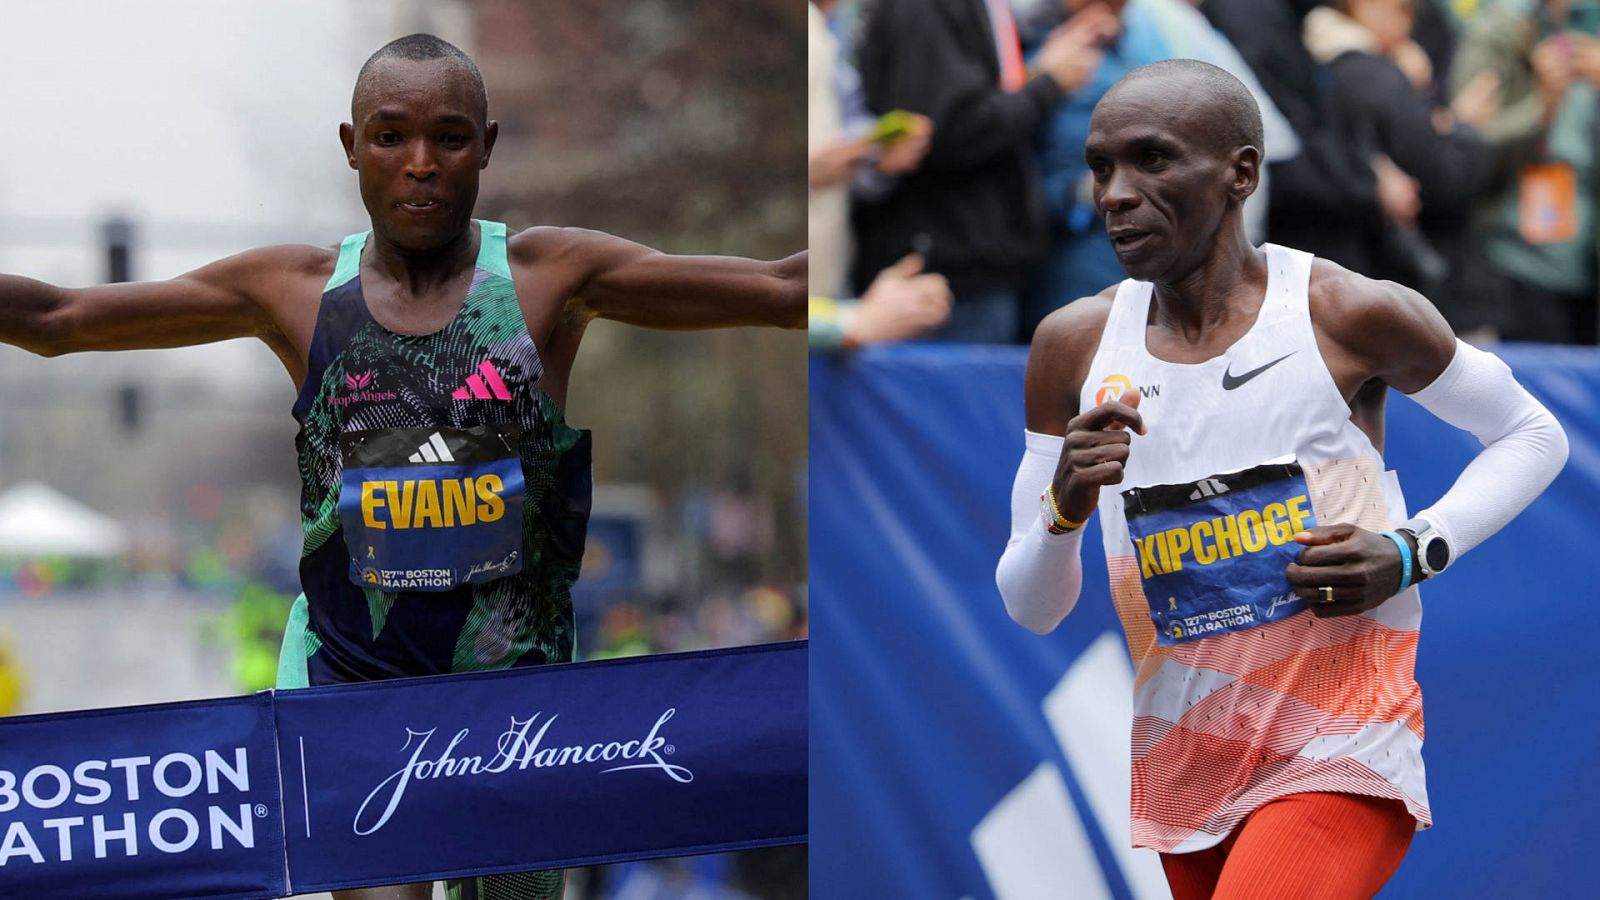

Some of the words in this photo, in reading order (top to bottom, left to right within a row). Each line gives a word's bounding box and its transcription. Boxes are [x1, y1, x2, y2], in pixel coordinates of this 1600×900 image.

[360, 389, 397, 402] Angels
[361, 474, 506, 530] EVANS
[1135, 495, 1311, 579] KIPCHOGE
[406, 569, 451, 579] BOSTON
[1208, 604, 1251, 621] BOSTON
[0, 747, 250, 812] BOSTON
[353, 726, 483, 836] John
